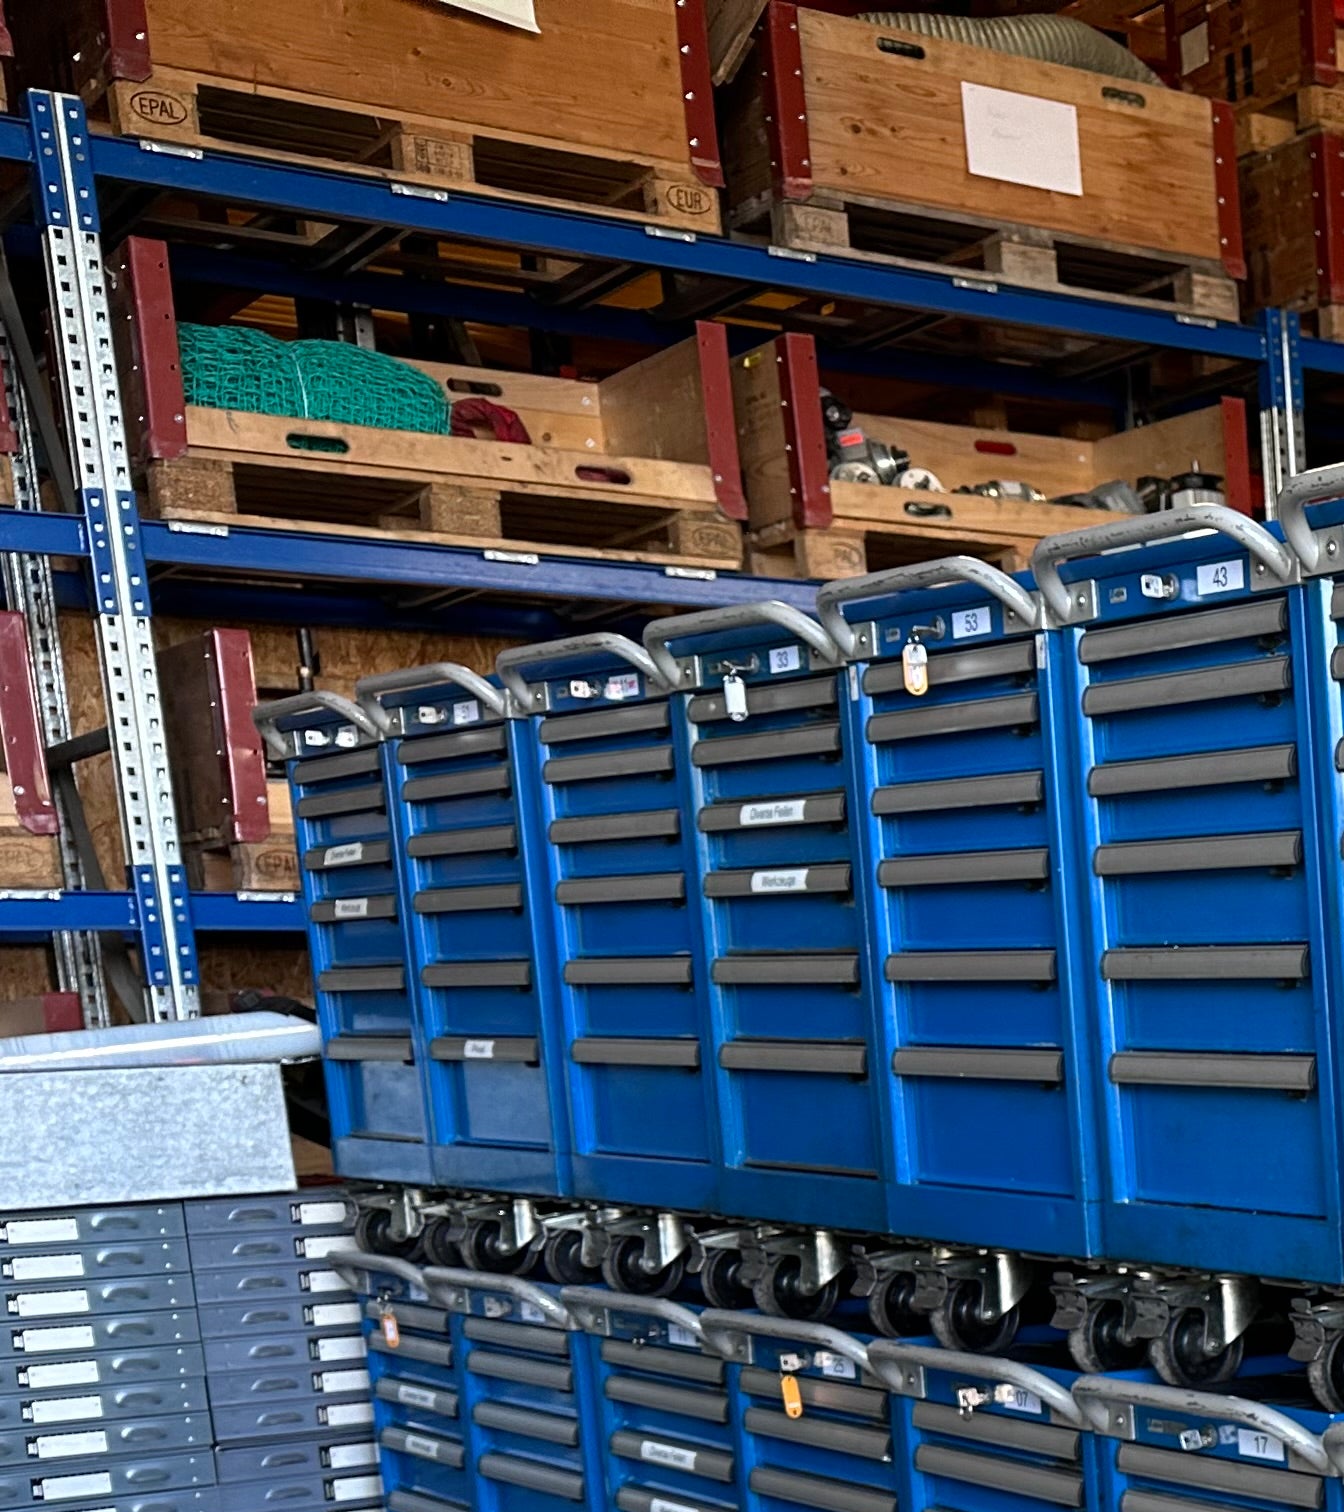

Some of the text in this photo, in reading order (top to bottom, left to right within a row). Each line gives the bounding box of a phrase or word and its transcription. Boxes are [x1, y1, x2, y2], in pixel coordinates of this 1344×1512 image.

[138, 97, 180, 120] EPAL
[676, 189, 702, 209] EUR
[1212, 566, 1228, 588] 43
[964, 613, 978, 633] 53
[776, 651, 789, 669] 33
[1016, 1390, 1029, 1407] 07
[1254, 1436, 1268, 1454] 17
